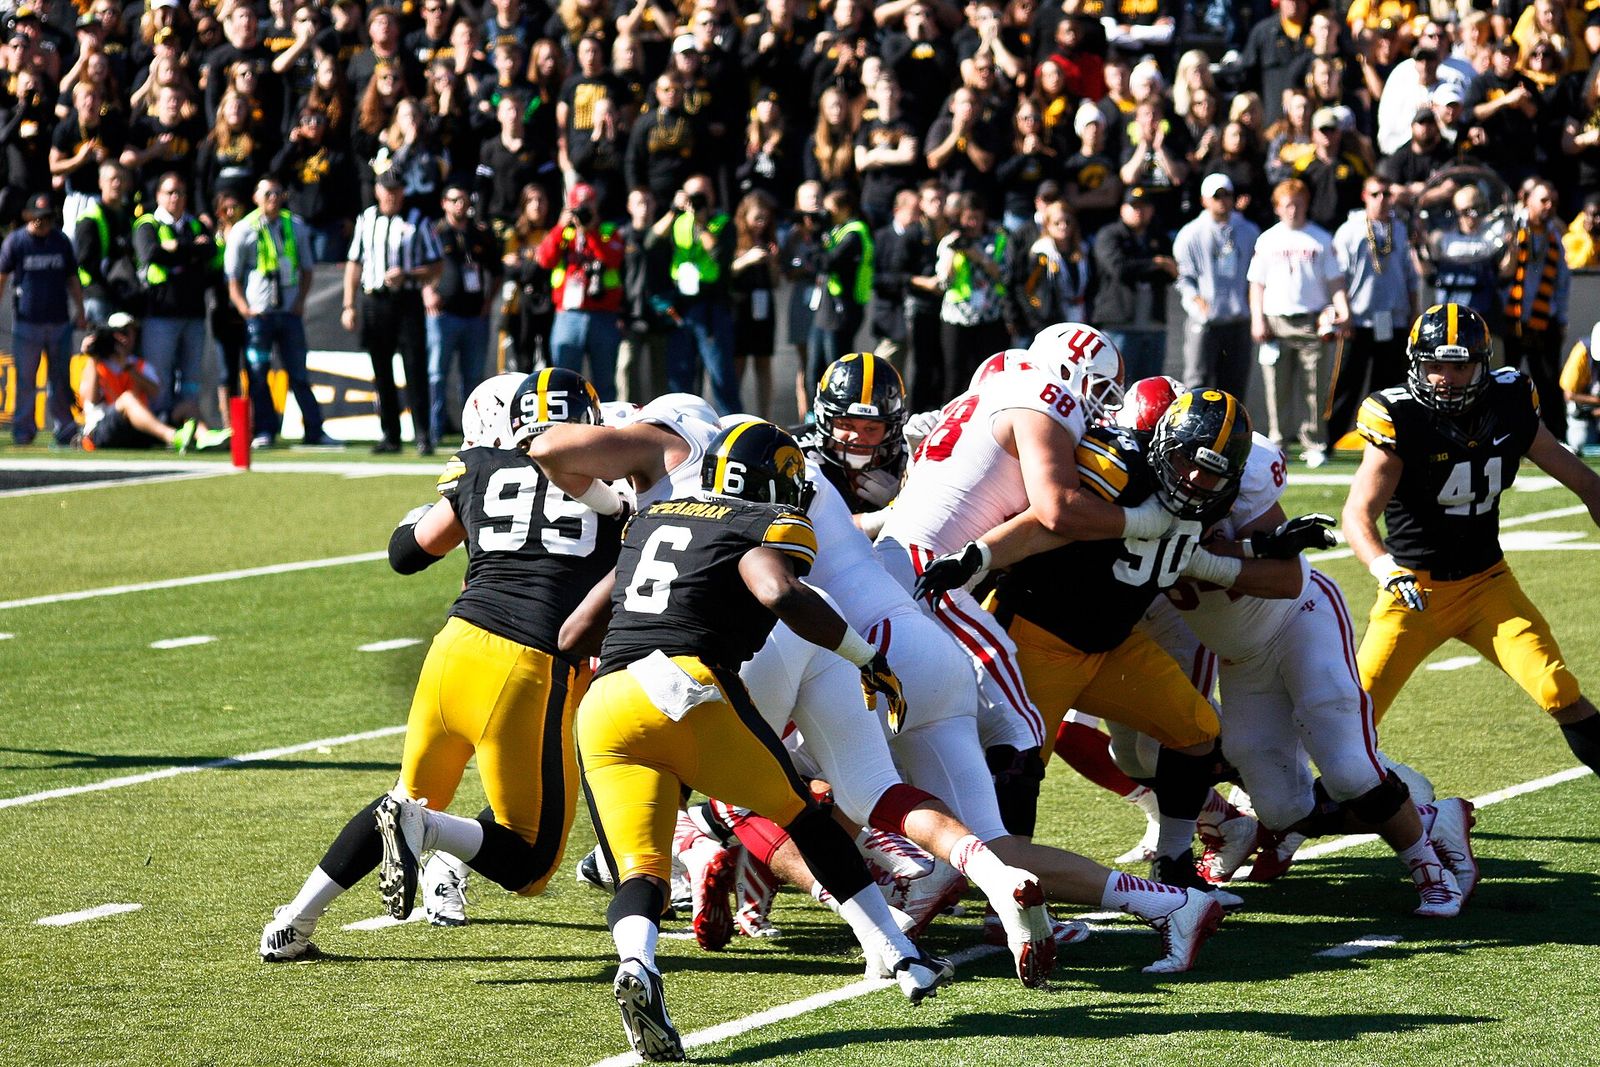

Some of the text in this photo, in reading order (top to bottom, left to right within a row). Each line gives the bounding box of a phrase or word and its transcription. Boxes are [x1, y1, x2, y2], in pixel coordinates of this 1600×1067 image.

[520, 390, 569, 425] 95
[1040, 383, 1077, 419] 68
[723, 461, 747, 495] 6
[1437, 456, 1502, 516] 41
[478, 465, 598, 558] 95
[624, 524, 693, 615] 6
[1112, 519, 1204, 589] 90
[266, 926, 297, 950] NIKE
